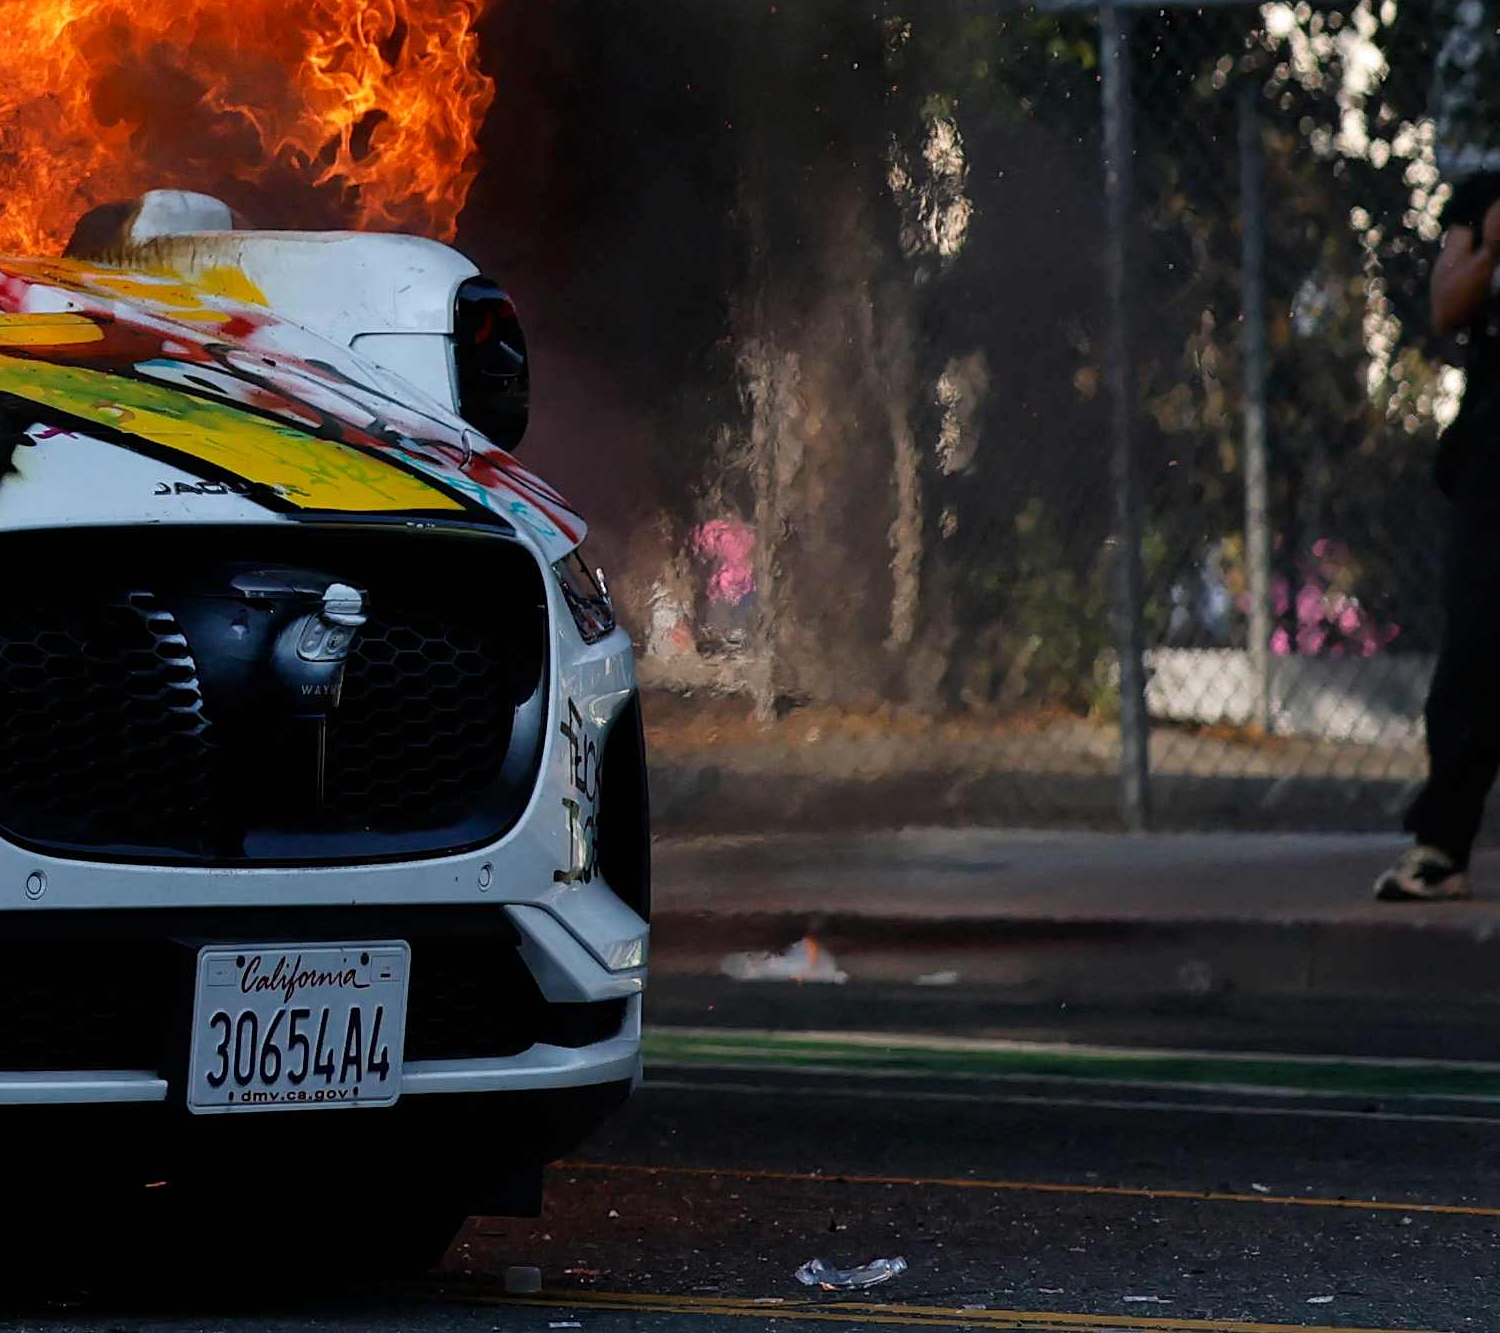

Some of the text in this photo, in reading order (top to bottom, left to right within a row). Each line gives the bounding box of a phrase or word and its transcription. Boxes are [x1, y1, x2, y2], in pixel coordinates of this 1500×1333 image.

[241, 954, 371, 1004] California
[206, 1005, 390, 1088] 30654A4
[241, 1087, 349, 1103] dmv.ca.gov
